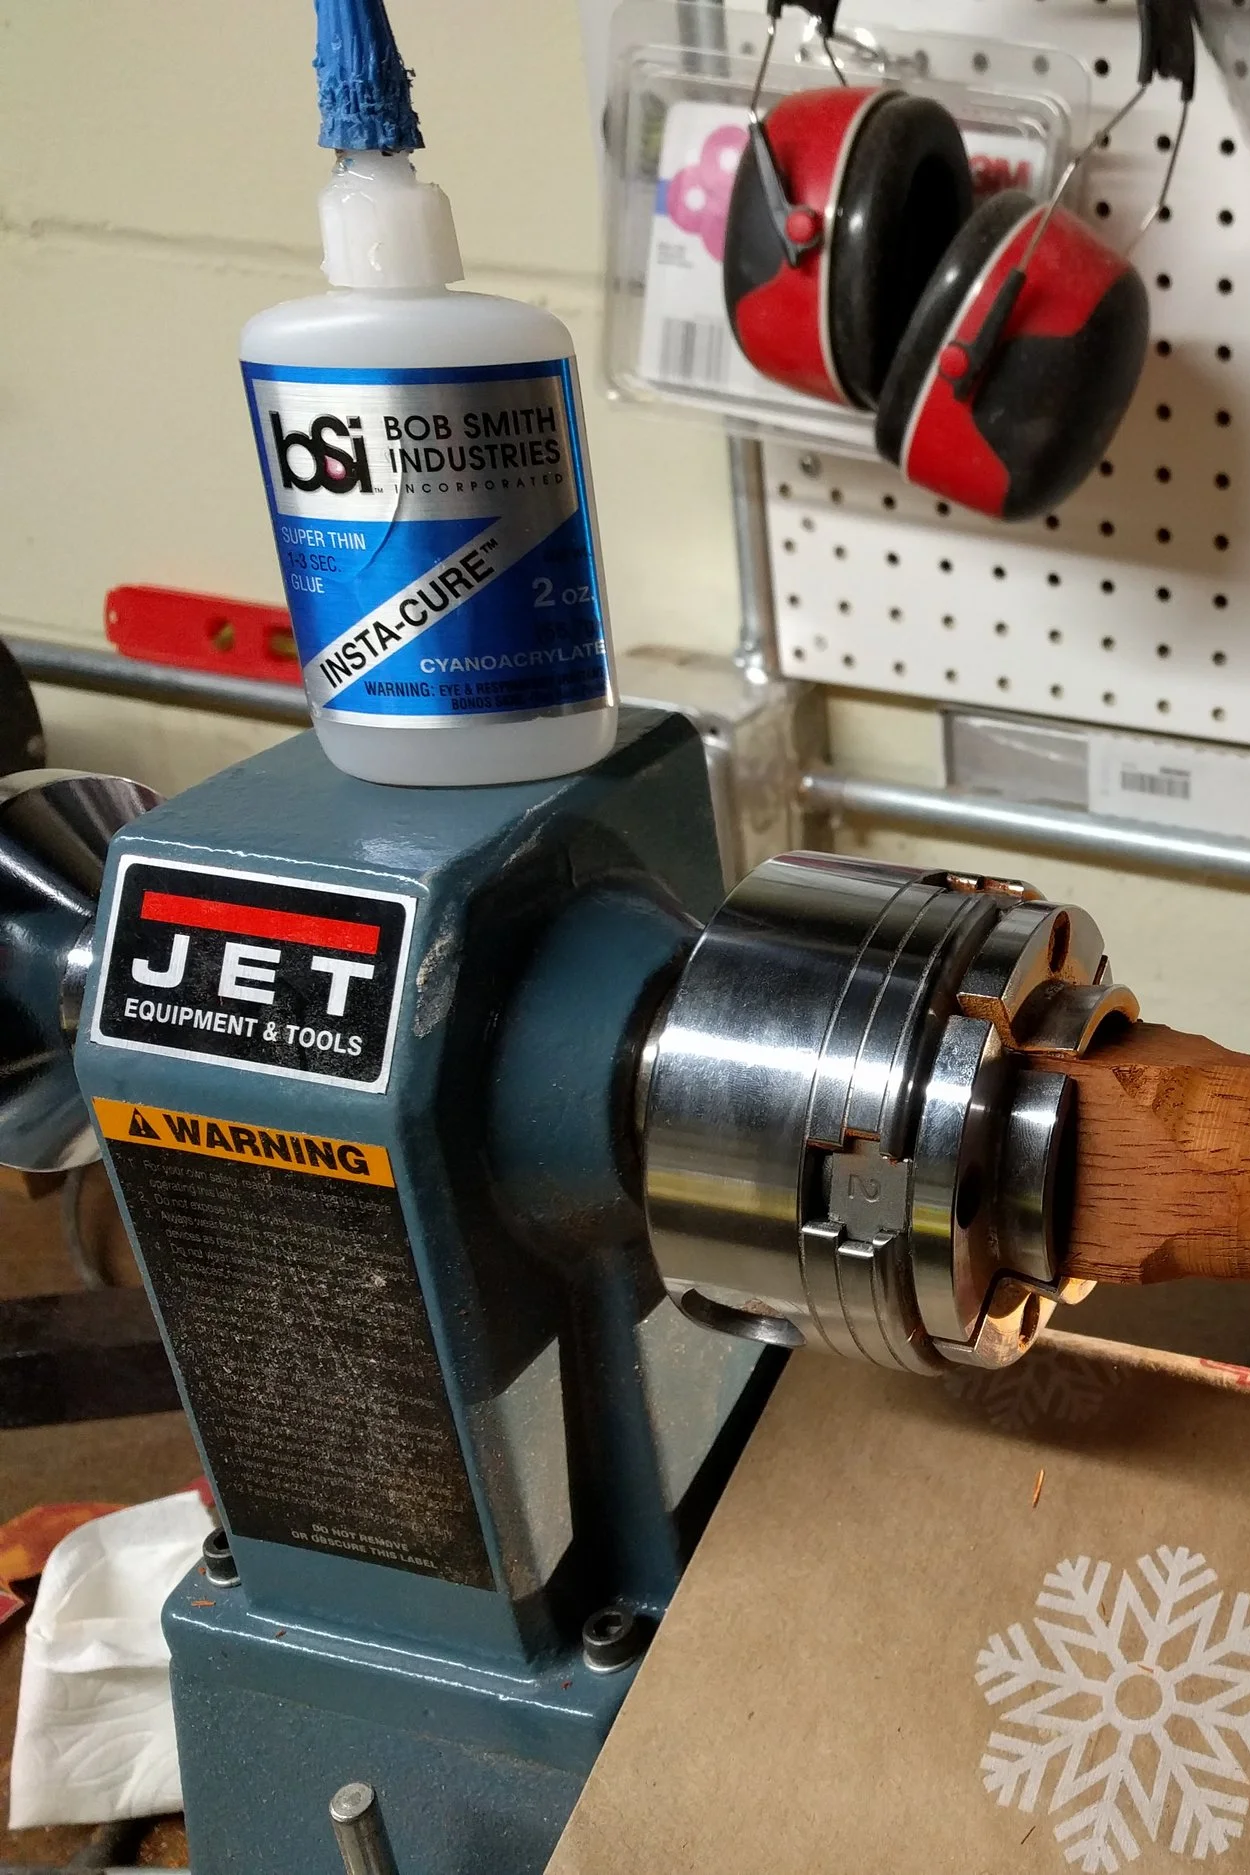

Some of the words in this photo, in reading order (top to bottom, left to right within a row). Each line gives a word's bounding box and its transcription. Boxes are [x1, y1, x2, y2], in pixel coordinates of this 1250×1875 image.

[384, 415, 451, 442] BOB
[463, 406, 557, 439] SMITH
[389, 439, 562, 474] INDUSTRIES
[394, 473, 564, 495] INCORPORATED
[281, 525, 325, 548] SUPER
[327, 530, 367, 551] THIN
[286, 551, 306, 570] 1-3
[307, 554, 342, 573] SEC.
[290, 575, 325, 594] GLUE
[531, 576, 555, 608] 2
[419, 640, 606, 675] CYANOACRYLATE
[364, 681, 436, 698] WARNING:
[439, 683, 461, 697] EYE
[464, 682, 473, 696] &
[131, 933, 375, 1017] JET
[124, 998, 258, 1038] EQUIPMENT
[262, 1021, 280, 1042] &
[286, 1024, 363, 1056] TOOLS
[163, 1113, 370, 1176] WARNING
[848, 1173, 882, 1203] 2
[289, 1528, 310, 1542] OR
[309, 1533, 369, 1554] OBSCURE
[367, 1545, 399, 1561] THIS
[398, 1552, 439, 1571] LABEL
[310, 1522, 330, 1535] DO
[330, 1527, 358, 1541] NOT
[357, 1532, 411, 1553] REMOVE
